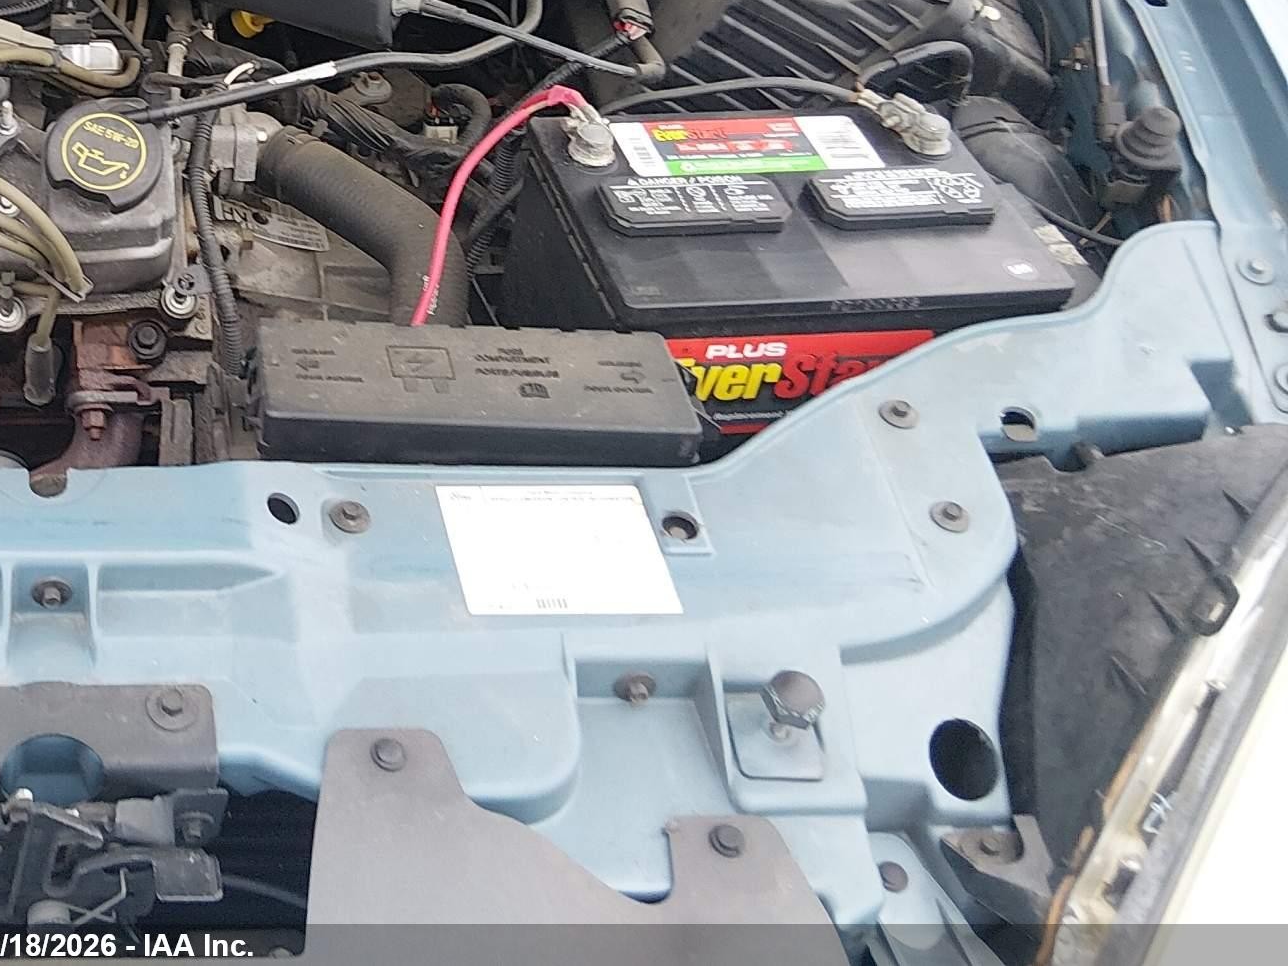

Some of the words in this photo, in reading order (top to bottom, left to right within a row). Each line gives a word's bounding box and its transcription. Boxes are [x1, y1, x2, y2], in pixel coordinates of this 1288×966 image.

[83, 121, 106, 136] SAE
[104, 129, 139, 149] 5W-20
[705, 342, 788, 359] PLUS
